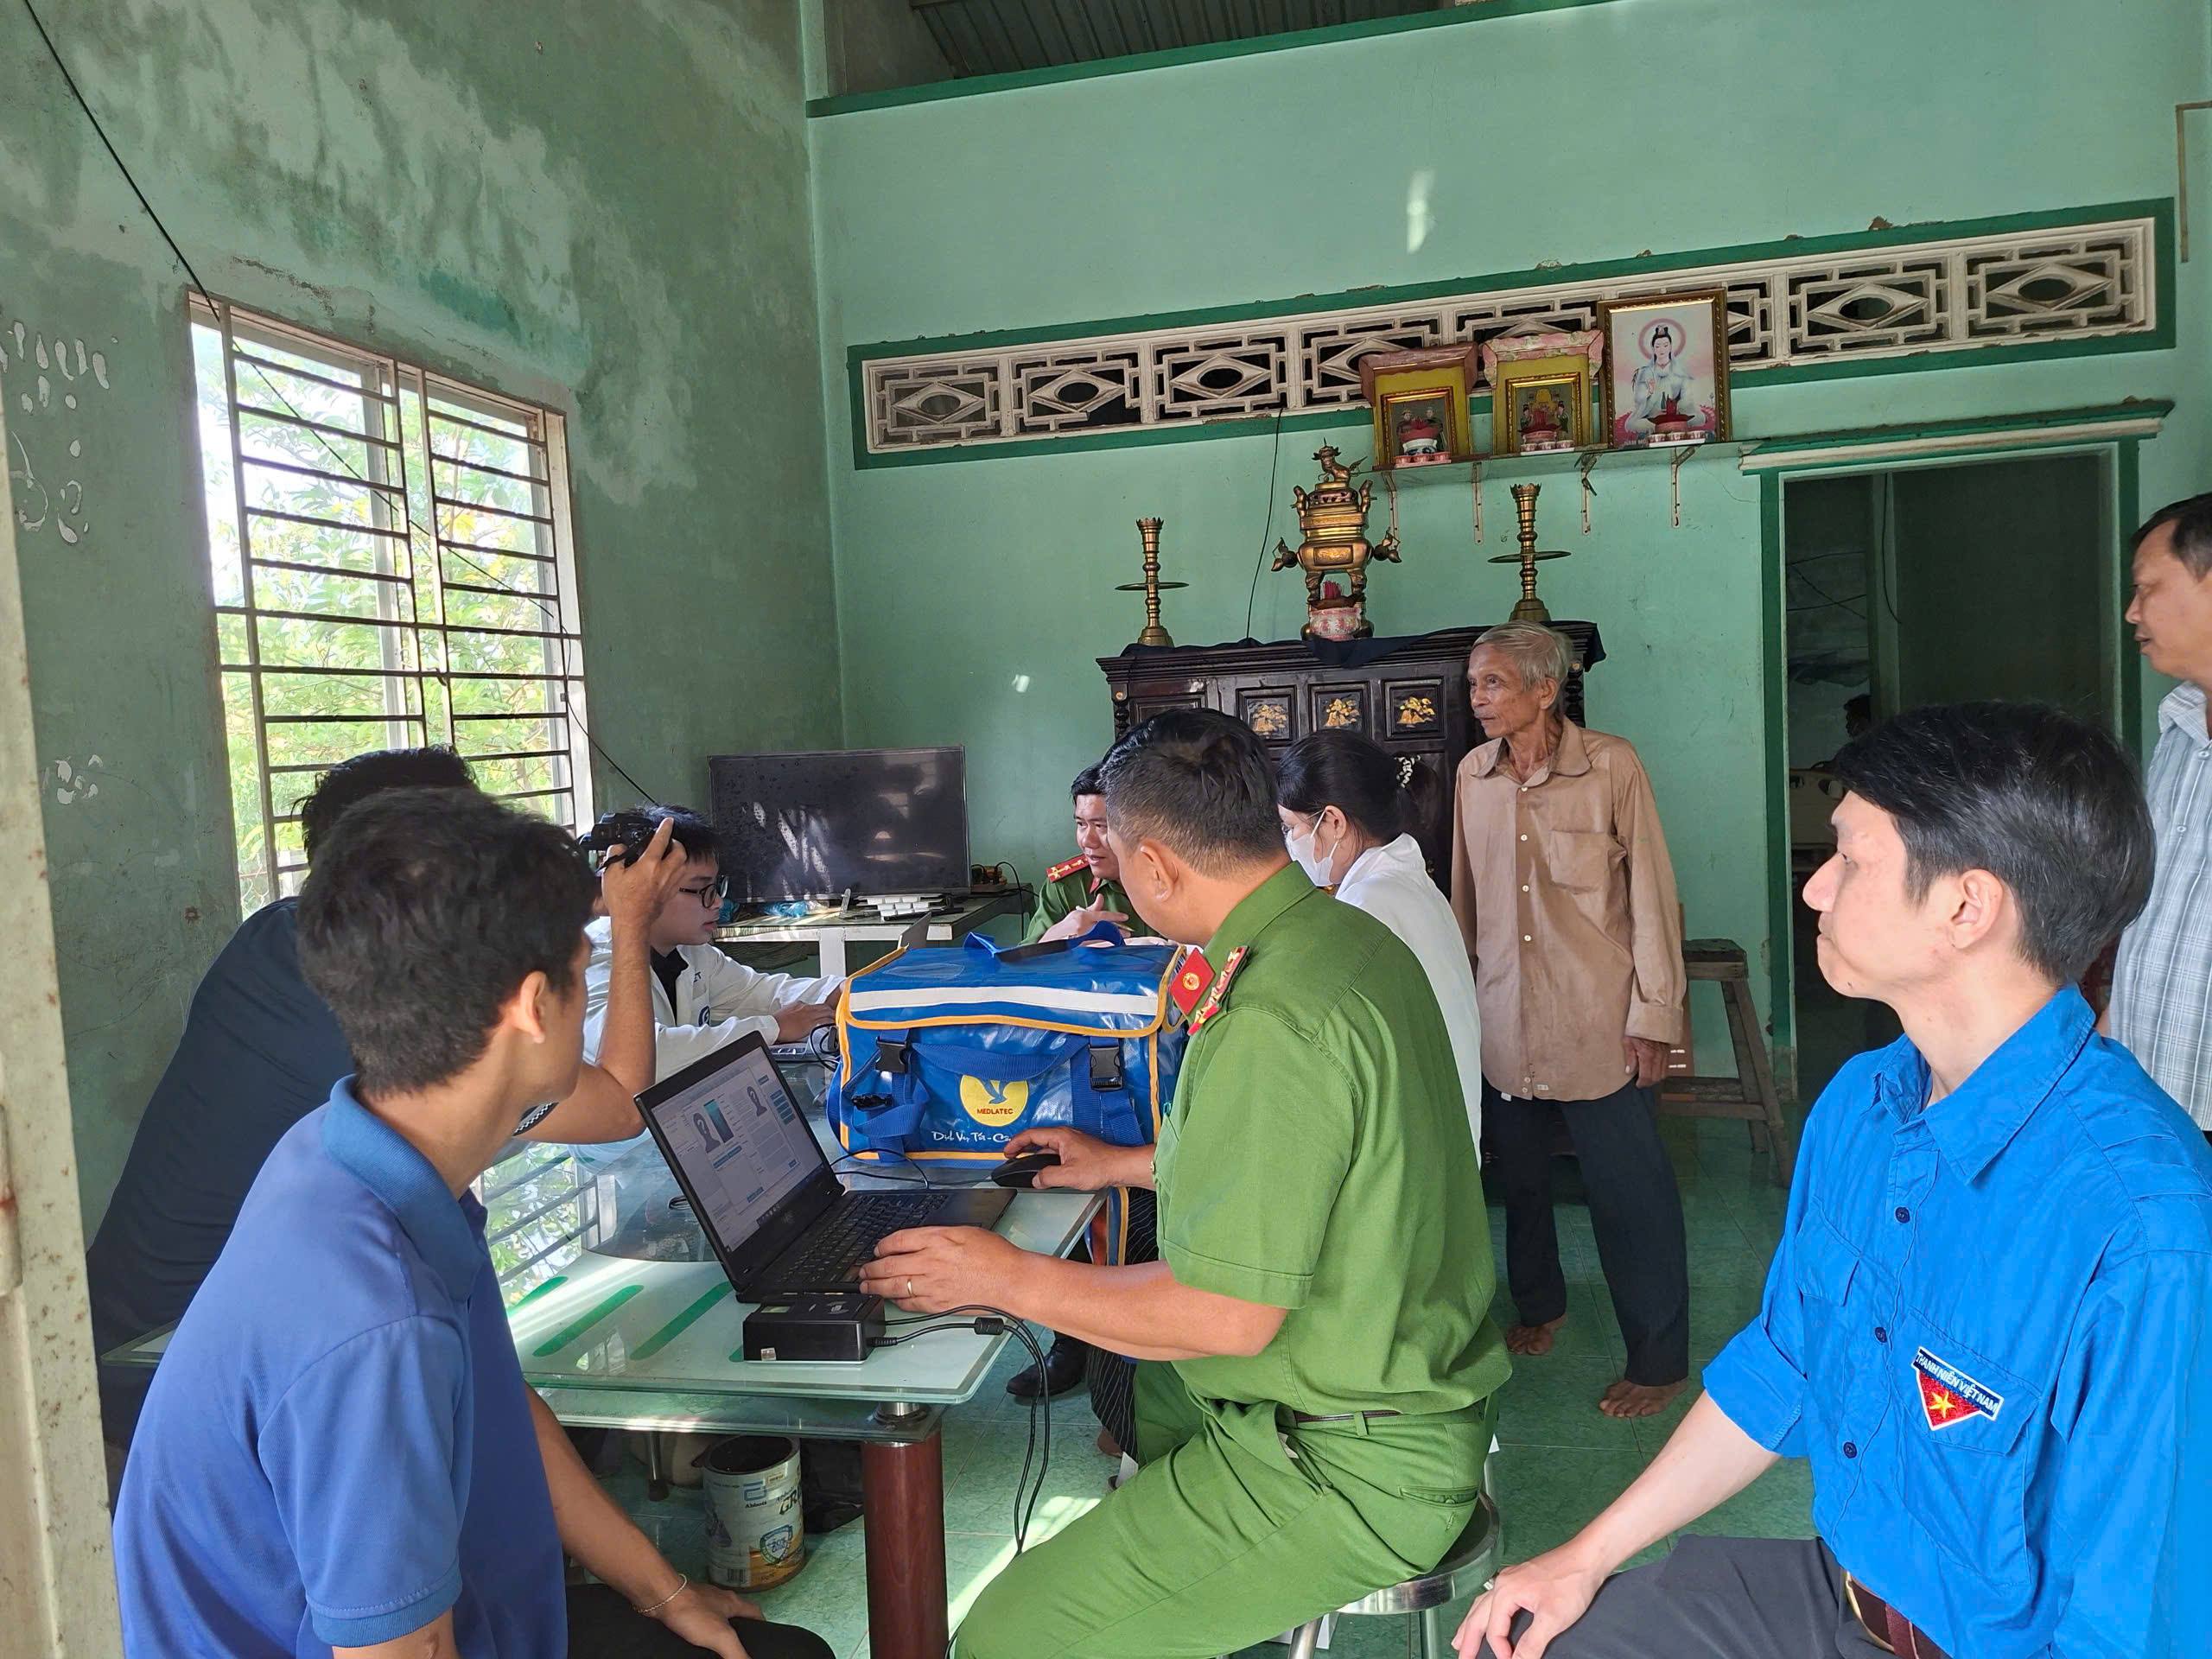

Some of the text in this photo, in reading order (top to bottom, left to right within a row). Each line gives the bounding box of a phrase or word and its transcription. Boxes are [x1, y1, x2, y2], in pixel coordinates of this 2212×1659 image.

[1915, 1352, 1999, 1413] THANH NIÊN VIỆT NAM
